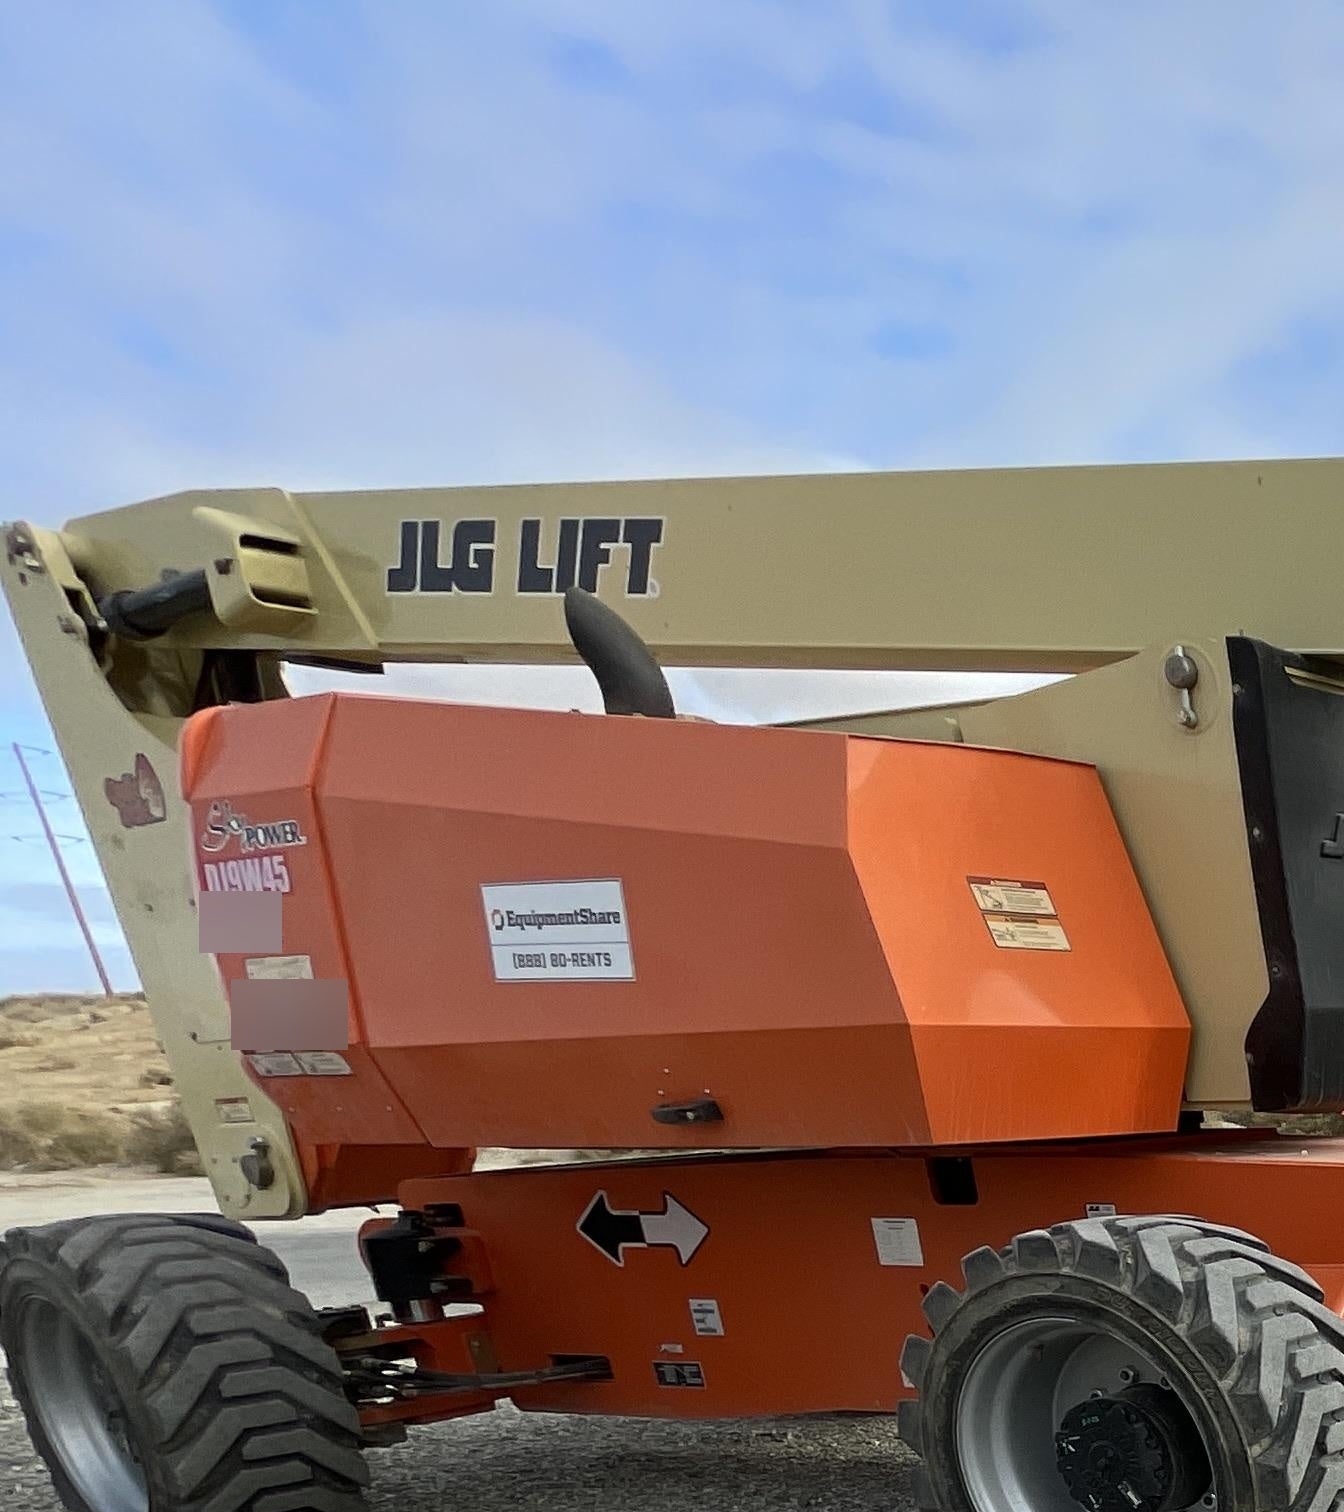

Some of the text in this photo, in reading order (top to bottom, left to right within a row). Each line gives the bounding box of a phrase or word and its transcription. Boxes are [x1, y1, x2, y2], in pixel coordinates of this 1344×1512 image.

[386, 517, 664, 595] JLG LIFT
[506, 908, 620, 930] EquipmentShare
